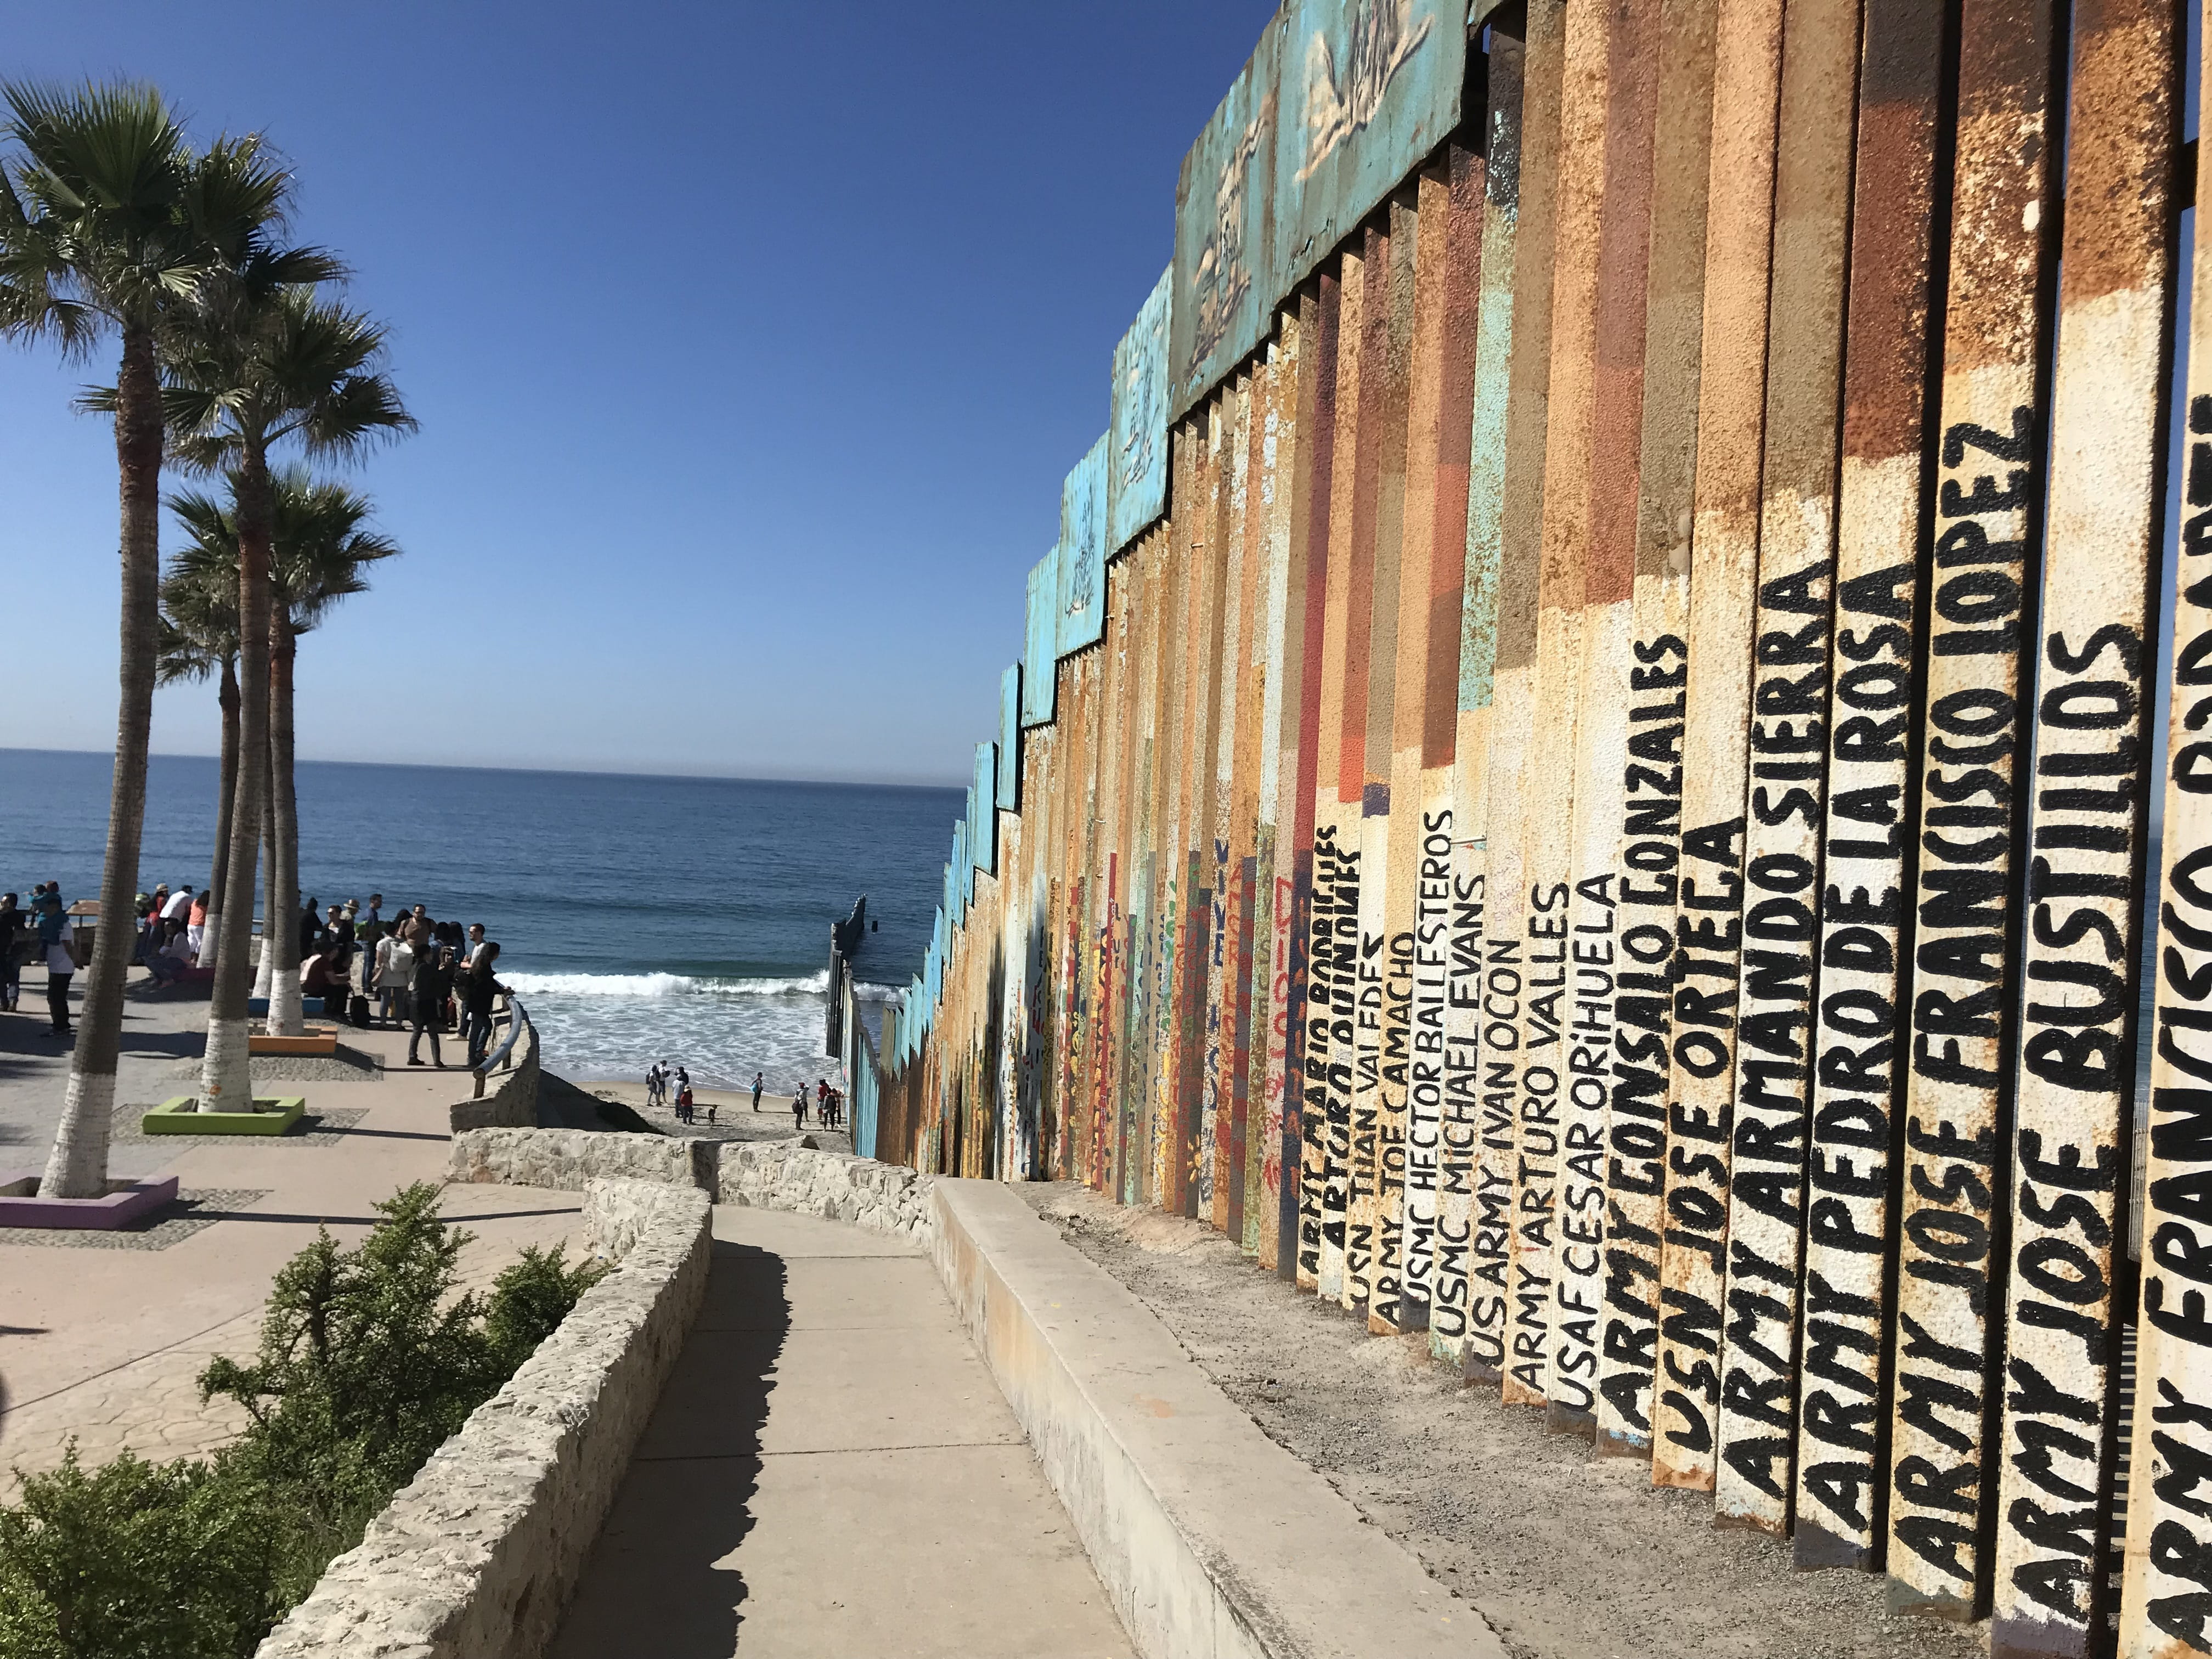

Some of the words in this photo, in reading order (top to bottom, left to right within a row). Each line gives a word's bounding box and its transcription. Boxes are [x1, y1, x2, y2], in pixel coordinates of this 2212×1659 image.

[1933, 405, 2034, 656] LOPEZ
[1752, 558, 1831, 830] SIERRA
[1834, 562, 1917, 762] ROSA
[1620, 634, 1687, 905] GONZALES
[1827, 783, 1903, 859] LA
[2024, 623, 2142, 1092] BUSTILLOS
[1449, 873, 1485, 1009] EVANS
[1526, 882, 1569, 1049] VALLES
[1673, 817, 1746, 1079] ORTEGA
[1822, 884, 1901, 974] DE
[1914, 689, 2016, 1090] FRANCISCO
[1381, 932, 1415, 1113] CAMACHO
[1483, 940, 1521, 1051] OCON
[1731, 854, 1814, 1228] ARMANDO
[1323, 1062, 1352, 1251] ARTURO
[1380, 1125, 1406, 1203] JOE
[1410, 1062, 1441, 1190] HECTOR
[1482, 1062, 1516, 1149] IVAN
[1519, 1066, 1559, 1246] ARTURO
[1664, 1102, 1732, 1274] JOSE
[1809, 989, 1895, 1254] PEDRO
[1300, 1160, 1323, 1274] ARMY
[1349, 1224, 1372, 1304] USN
[1375, 1214, 1403, 1327] ARMY
[1407, 1204, 1434, 1302] USMC
[1435, 1215, 1470, 1337] USMC
[1562, 1122, 1605, 1277] CESAR
[1904, 1116, 1996, 1316] JOSE
[2016, 1128, 2120, 1365] JOSE
[1511, 1263, 1551, 1392] ARMY
[1557, 1281, 1598, 1412] USAF
[1600, 1199, 1662, 1431] ARMY
[1661, 1287, 1723, 1454] USN
[1722, 1239, 1796, 1500] ARMY
[1802, 1268, 1880, 1533] ARMY
[1894, 1312, 1984, 1583] ARMY
[2008, 1357, 2104, 1622] ARMY
[2147, 1378, 2212, 1651] ARMY
